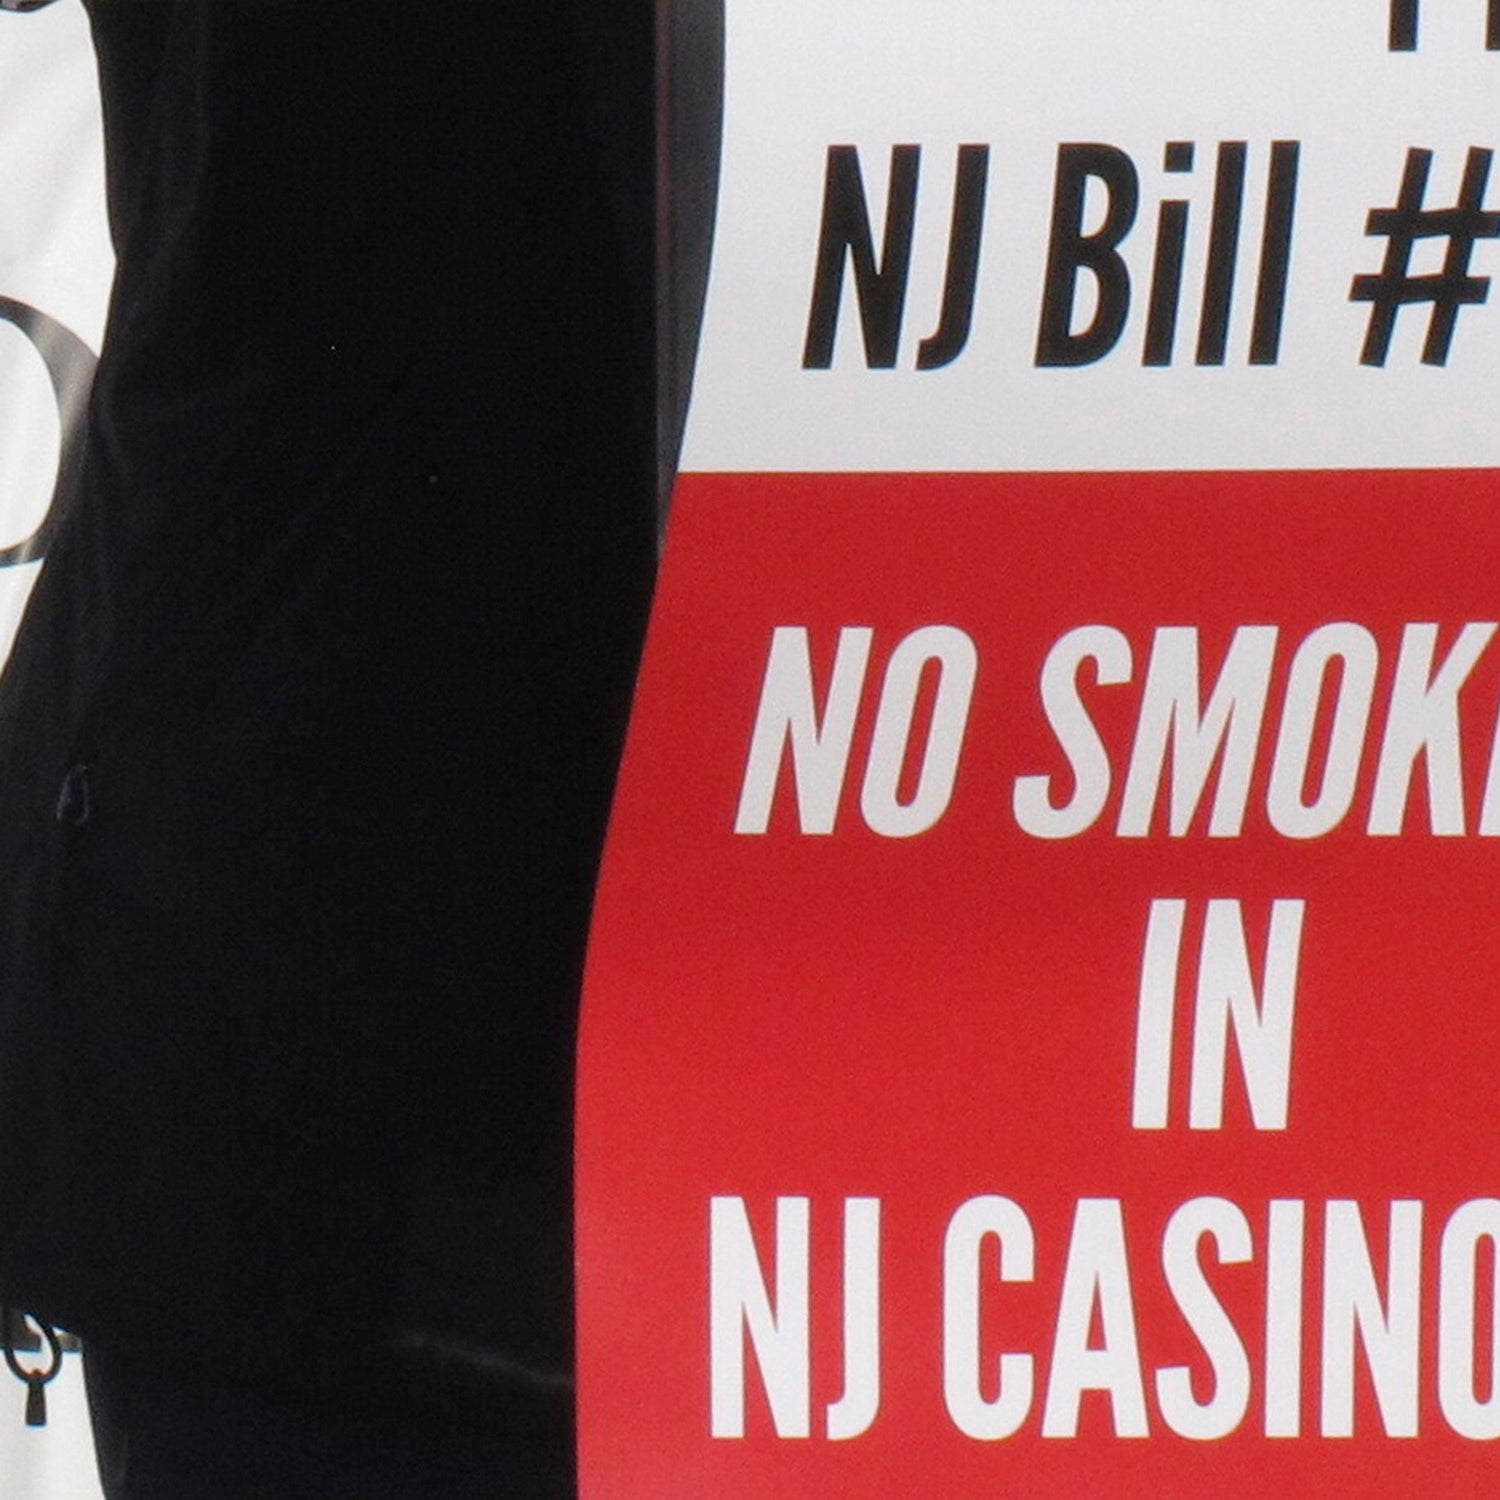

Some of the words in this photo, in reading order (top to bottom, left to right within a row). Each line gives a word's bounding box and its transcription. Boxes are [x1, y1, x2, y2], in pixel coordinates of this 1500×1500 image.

[801, 143, 992, 372] NJ
[1033, 139, 1302, 369] Bill
[733, 623, 980, 840] NO
[1131, 898, 1306, 1132] IN
[708, 1194, 882, 1443] NJ
